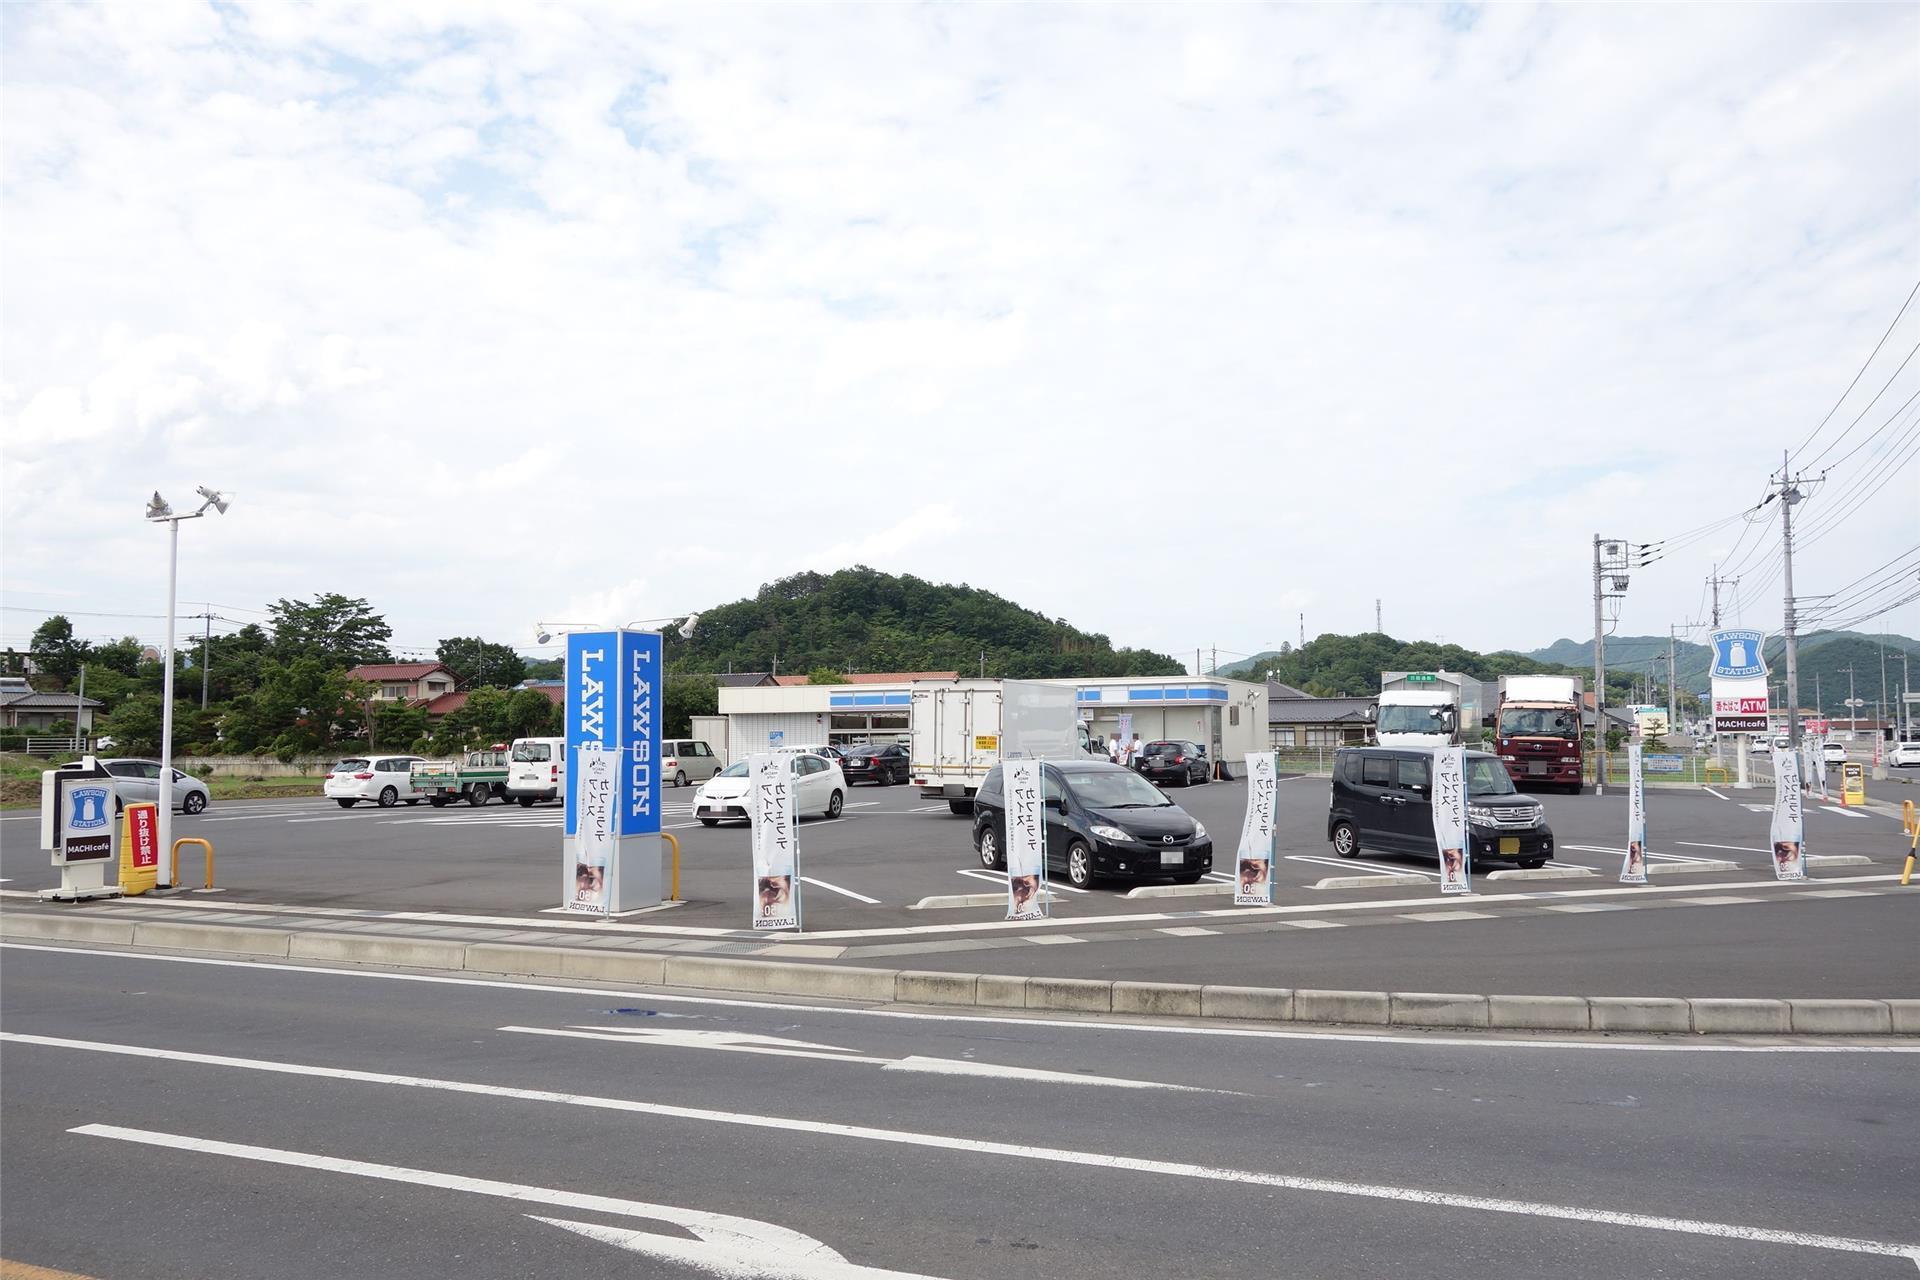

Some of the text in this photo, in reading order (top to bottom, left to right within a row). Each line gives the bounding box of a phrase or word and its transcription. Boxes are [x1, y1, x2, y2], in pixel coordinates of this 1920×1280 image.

[1715, 632, 1759, 642] LAWSON
[1717, 665, 1760, 675] STATION
[1741, 701, 1766, 711] ATM
[633, 650, 651, 816] LAWSON
[74, 790, 105, 799] LAWSON
[73, 817, 104, 827] STATION
[137, 810, 152, 864] 通り抜け禁止
[68, 845, 93, 853] MACHI
